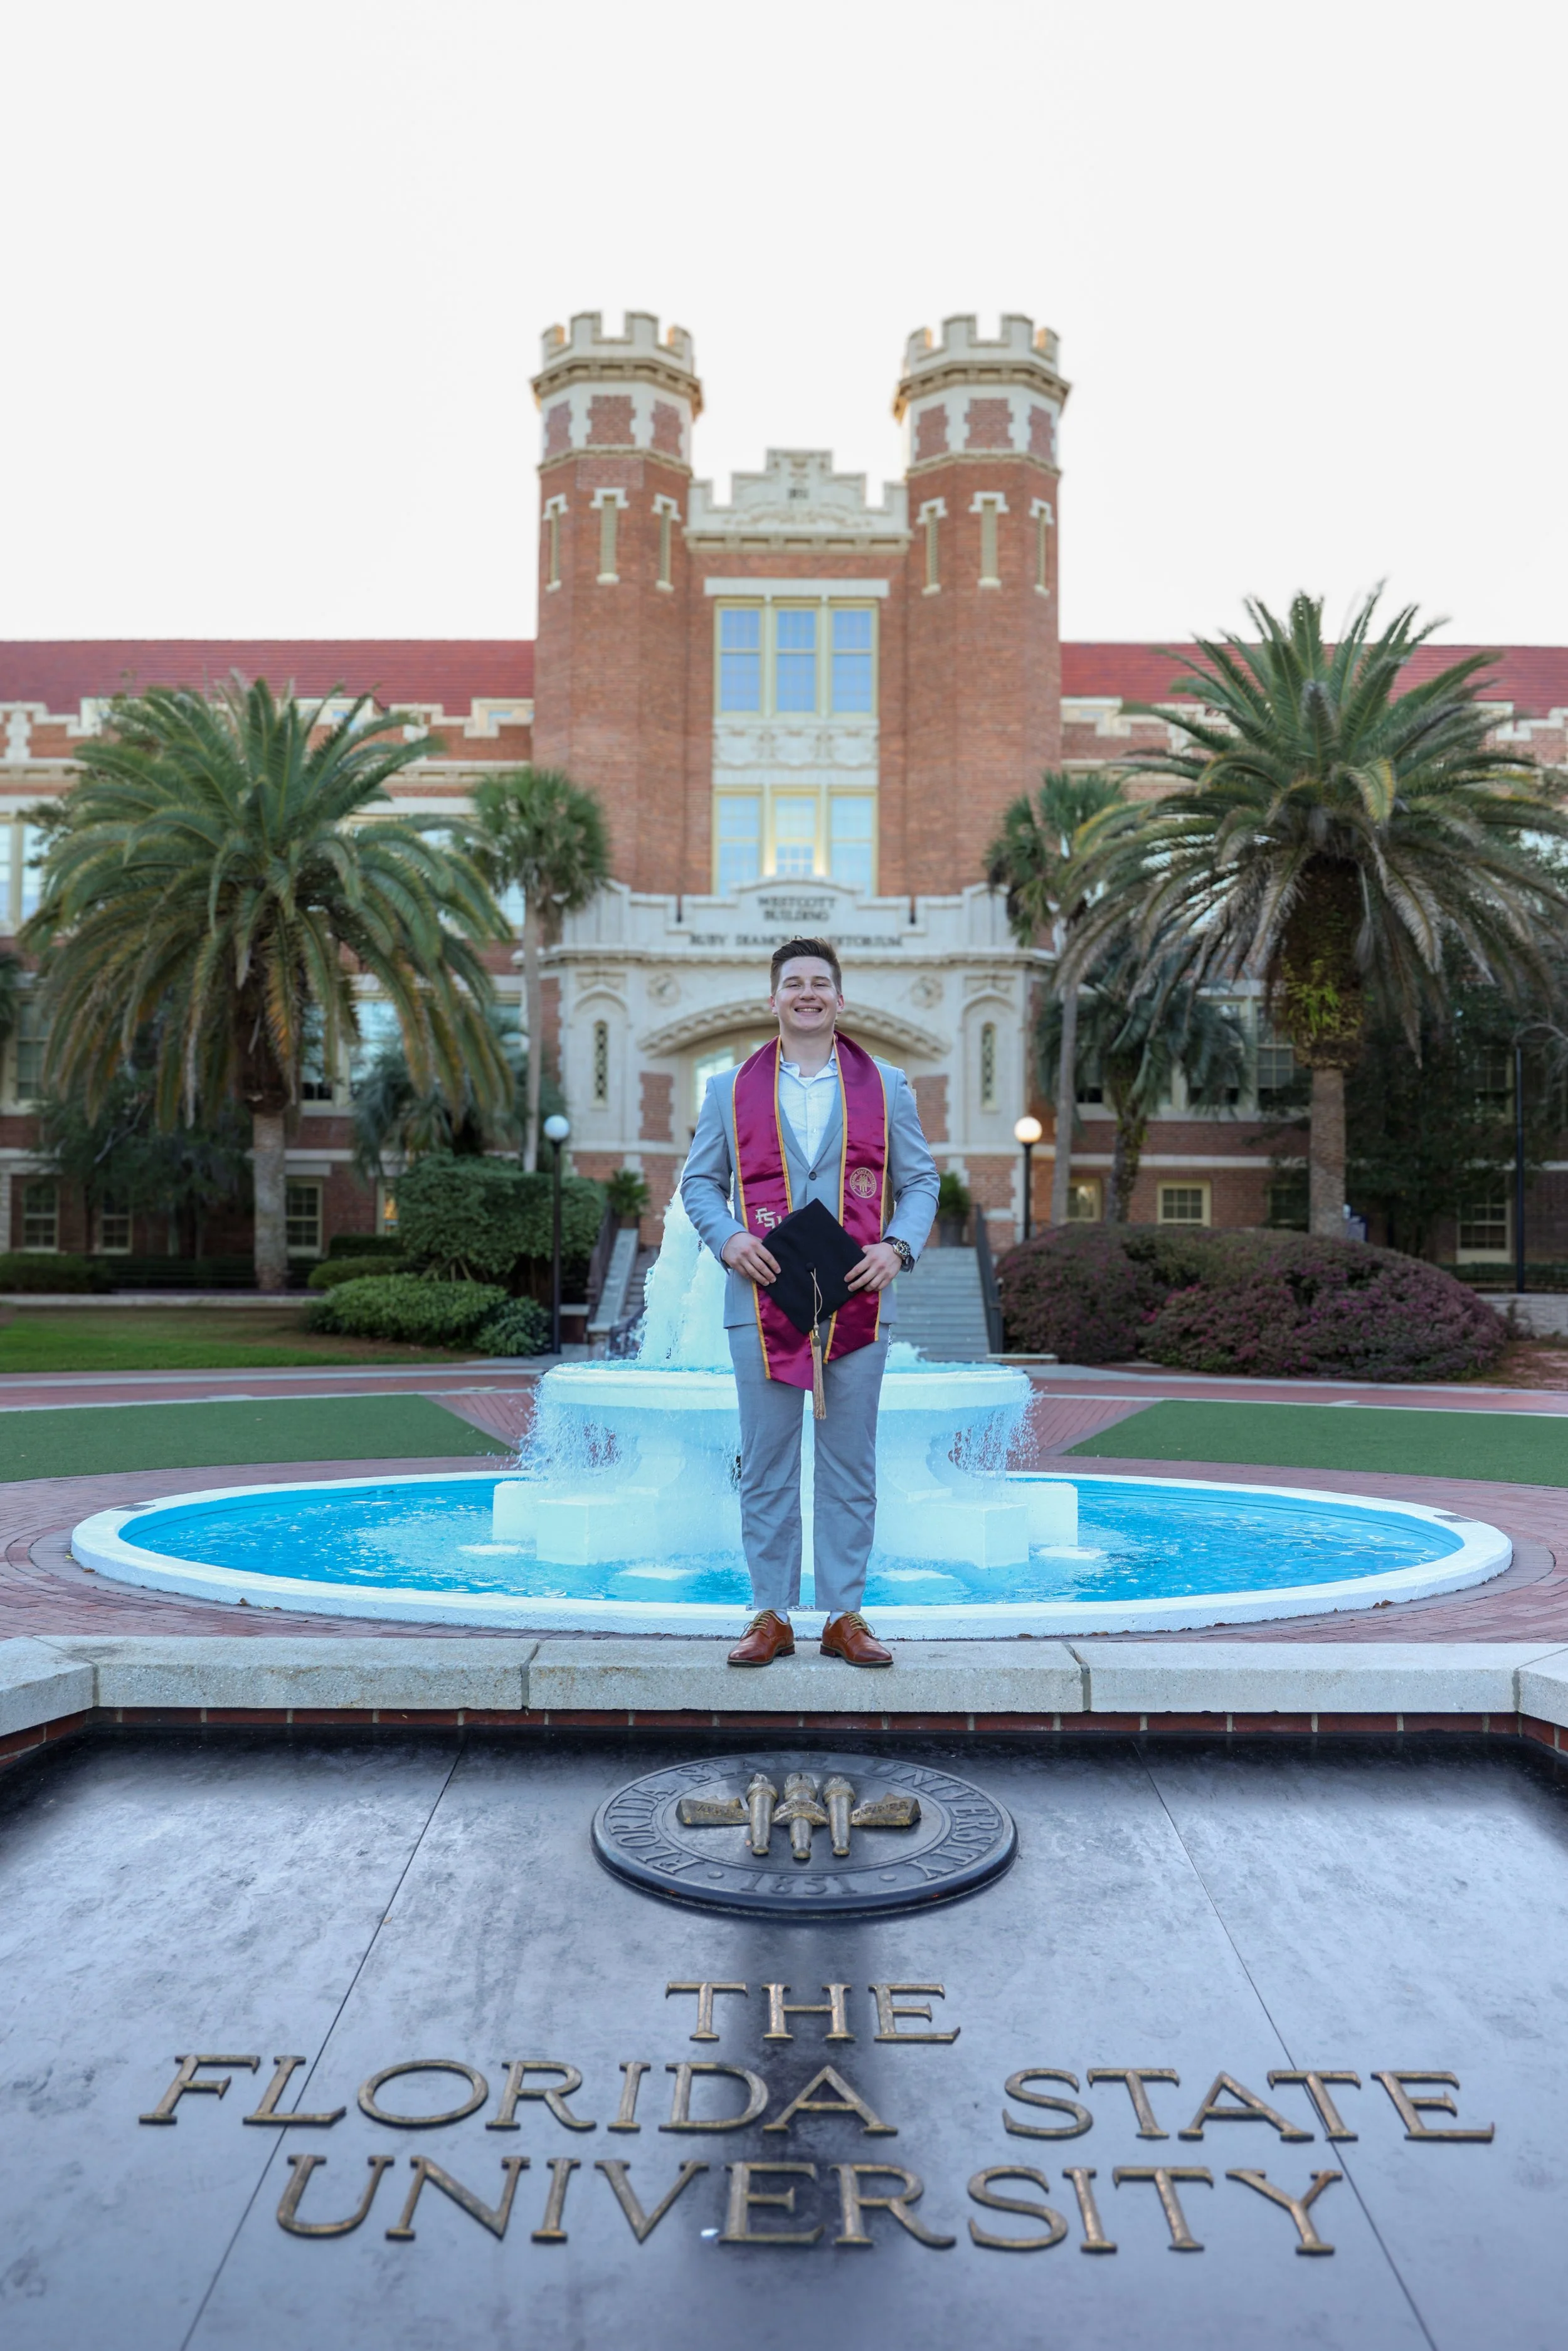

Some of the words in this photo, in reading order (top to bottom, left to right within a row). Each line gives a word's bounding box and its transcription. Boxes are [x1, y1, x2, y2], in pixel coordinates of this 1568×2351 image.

[755, 1207, 782, 1229] FS
[609, 1788, 705, 1875] FLORIDA
[677, 1756, 829, 1783] STATE
[865, 1759, 999, 1880] UNIVERSITY
[740, 1871, 858, 1895] 1851
[665, 1981, 961, 2044] THE
[138, 2053, 898, 2135] FLORIDA
[1002, 2067, 1495, 2143] STATE
[275, 2153, 1343, 2256] UNIVERSITY
